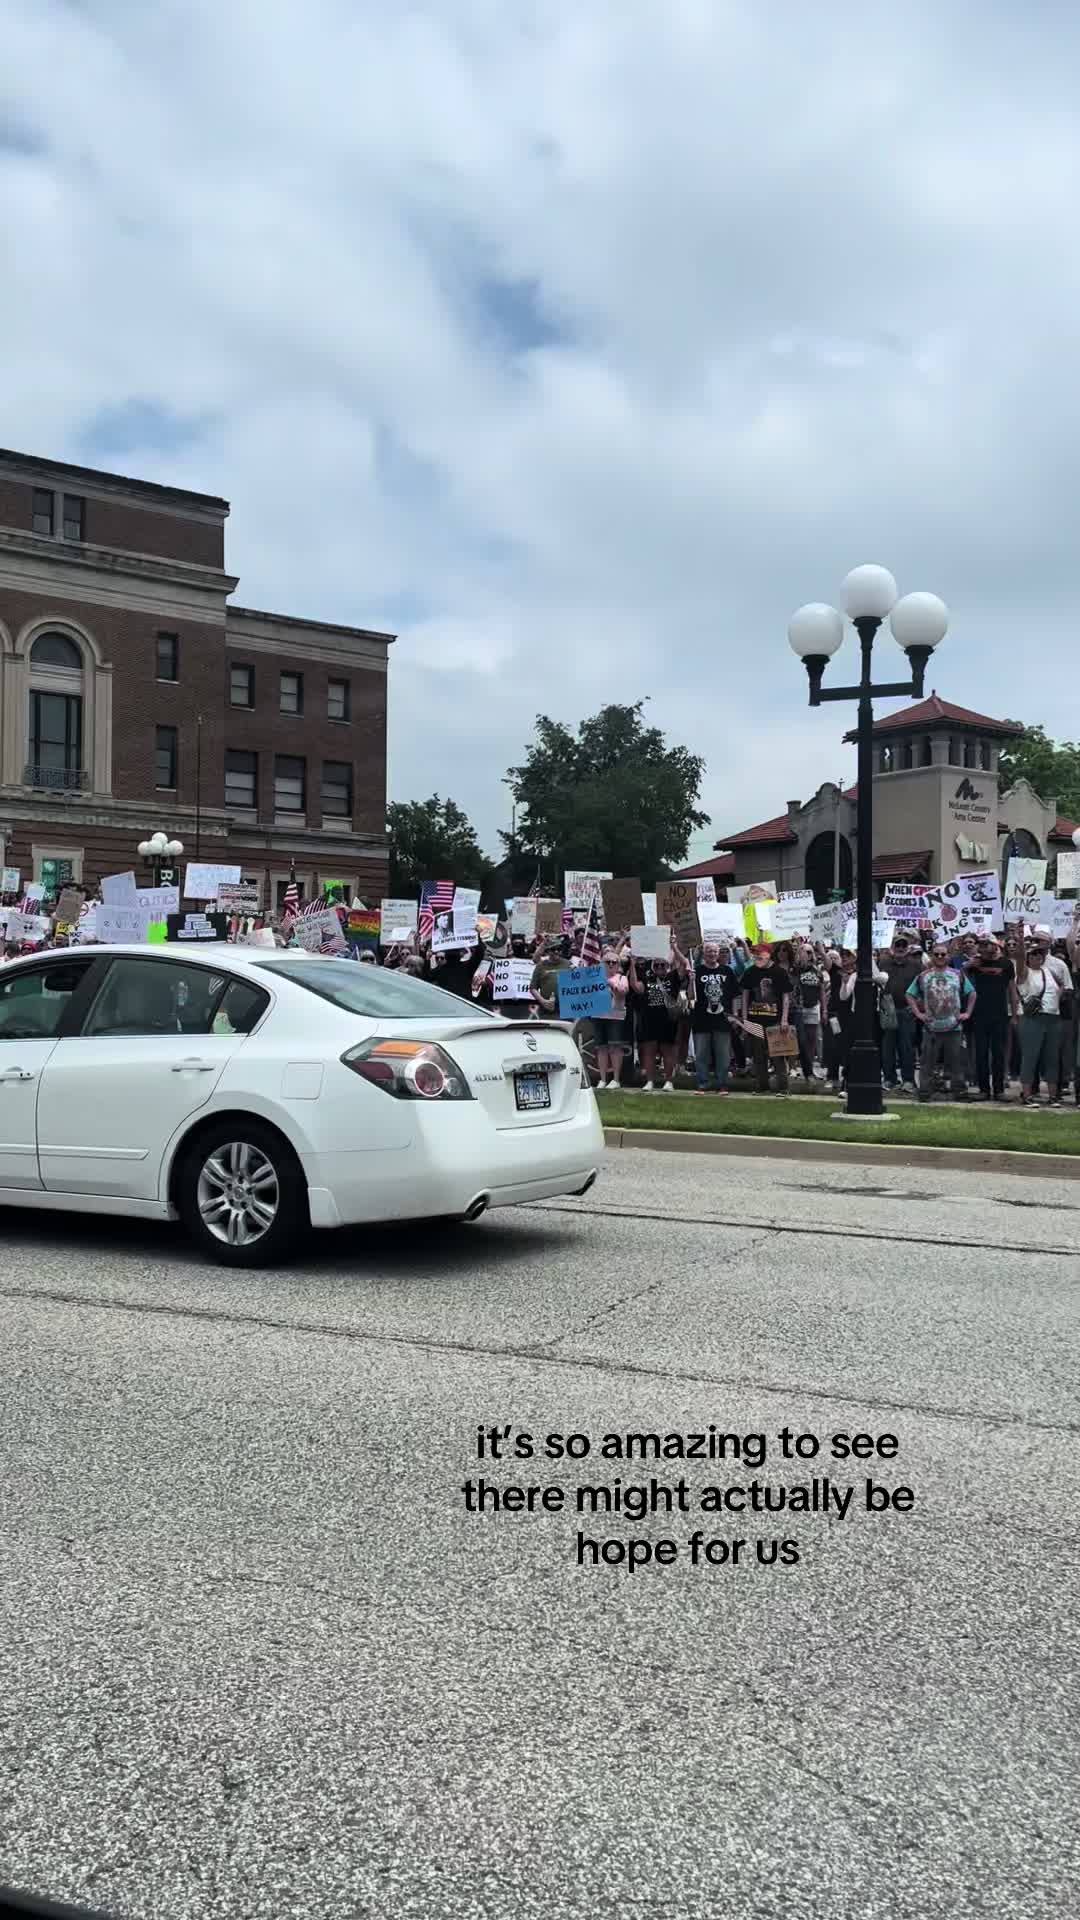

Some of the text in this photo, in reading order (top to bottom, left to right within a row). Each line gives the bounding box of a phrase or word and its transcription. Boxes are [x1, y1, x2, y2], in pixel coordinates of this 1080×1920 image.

[670, 885, 686, 897] NO
[887, 885, 912, 895] WHEN
[925, 882, 960, 908] NO
[1014, 883, 1037, 897] NO
[885, 896, 916, 906] BECOMES
[1004, 897, 1041, 914] KINGS
[495, 972, 509, 980] NO
[700, 974, 727, 983] OBEY
[494, 984, 509, 993] NO
[581, 983, 606, 994] KING
